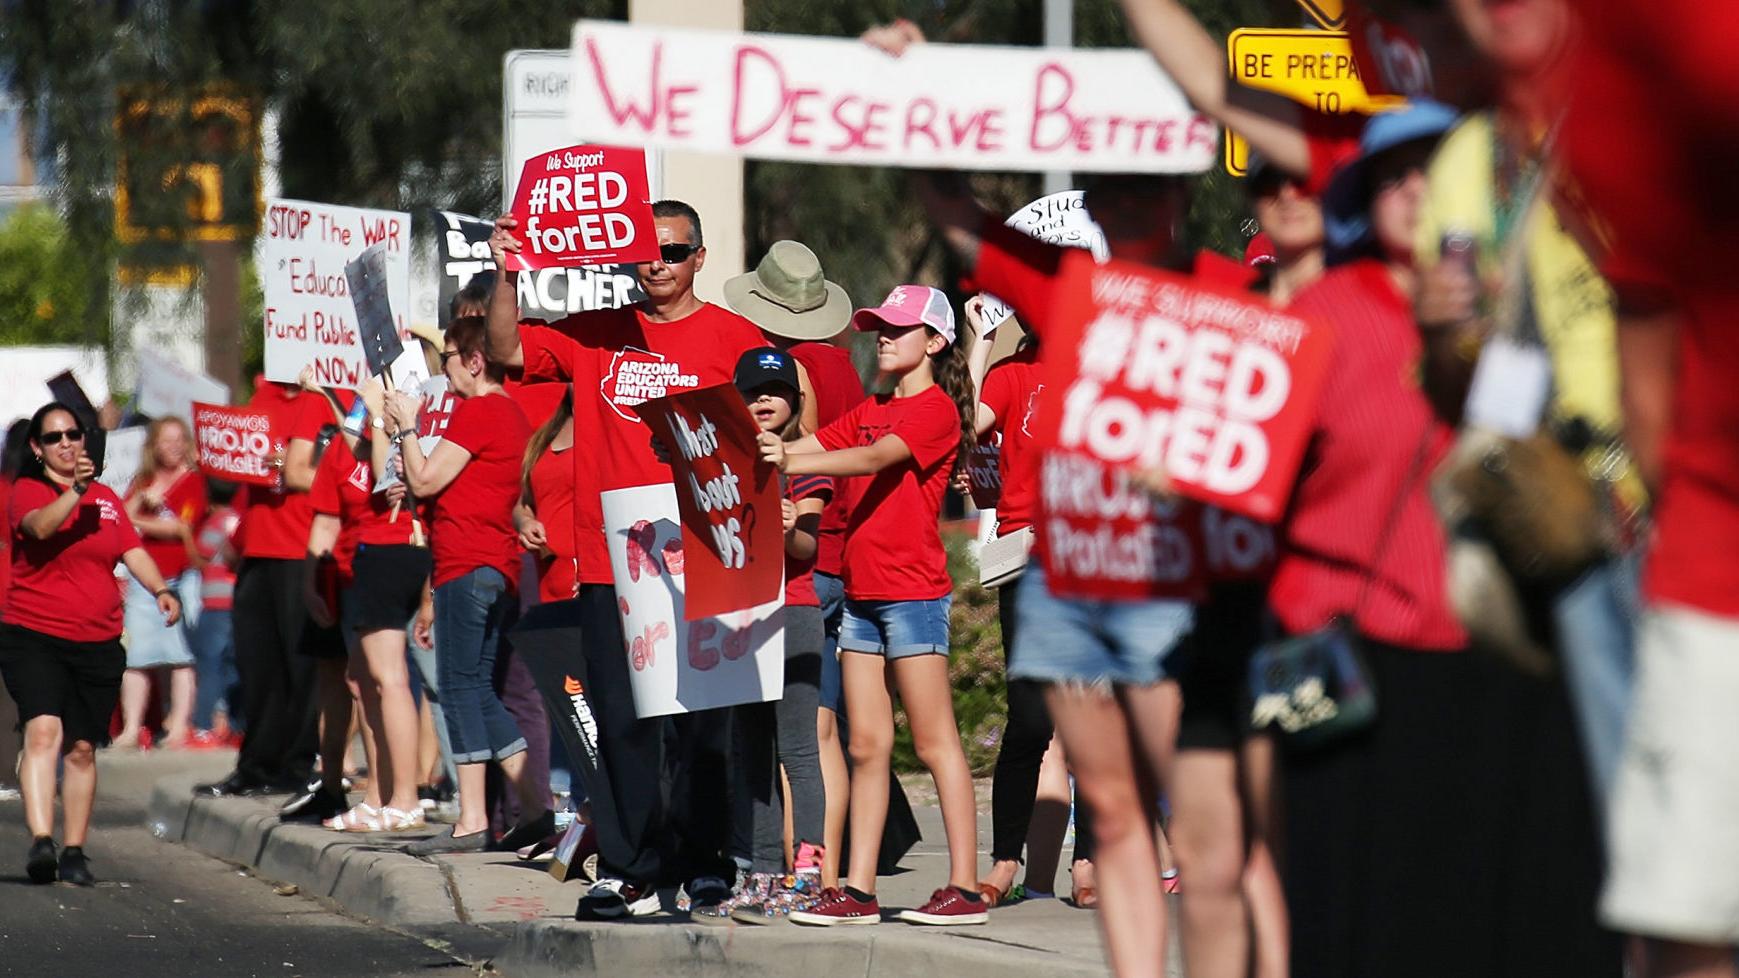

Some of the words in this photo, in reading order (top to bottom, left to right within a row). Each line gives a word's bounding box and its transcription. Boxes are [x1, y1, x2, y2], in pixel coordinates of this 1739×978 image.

[523, 72, 570, 97] RIGH
[1244, 53, 1273, 78] BE
[1287, 53, 1361, 81] PREPA
[585, 36, 699, 138] WE
[731, 45, 1004, 154] DESERVE
[1029, 61, 1215, 156] BETTER
[1313, 91, 1341, 113] TO
[546, 154, 561, 172] We
[563, 150, 604, 172] Support
[527, 171, 628, 215] #RED
[1027, 197, 1086, 225] Stud
[268, 205, 311, 241] STOP
[318, 213, 351, 246] The
[360, 215, 400, 252] WAR
[445, 230, 491, 259] Ba
[525, 212, 636, 255] forED
[1030, 214, 1065, 237] and
[445, 261, 647, 315] TACHER
[265, 308, 307, 341] Fund
[313, 311, 355, 346] Public
[1091, 270, 1150, 307] WE
[1149, 282, 1309, 354] SUPPORT
[616, 372, 699, 387] EDUCATORS
[618, 361, 680, 375] ARIZONA
[1078, 311, 1291, 423] #RED
[614, 384, 667, 399] UNITED
[199, 426, 270, 456] #ROJO
[665, 410, 718, 462] What
[1058, 378, 1270, 495] forED
[1202, 502, 1276, 571] fo
[570, 693, 598, 750] Hank
